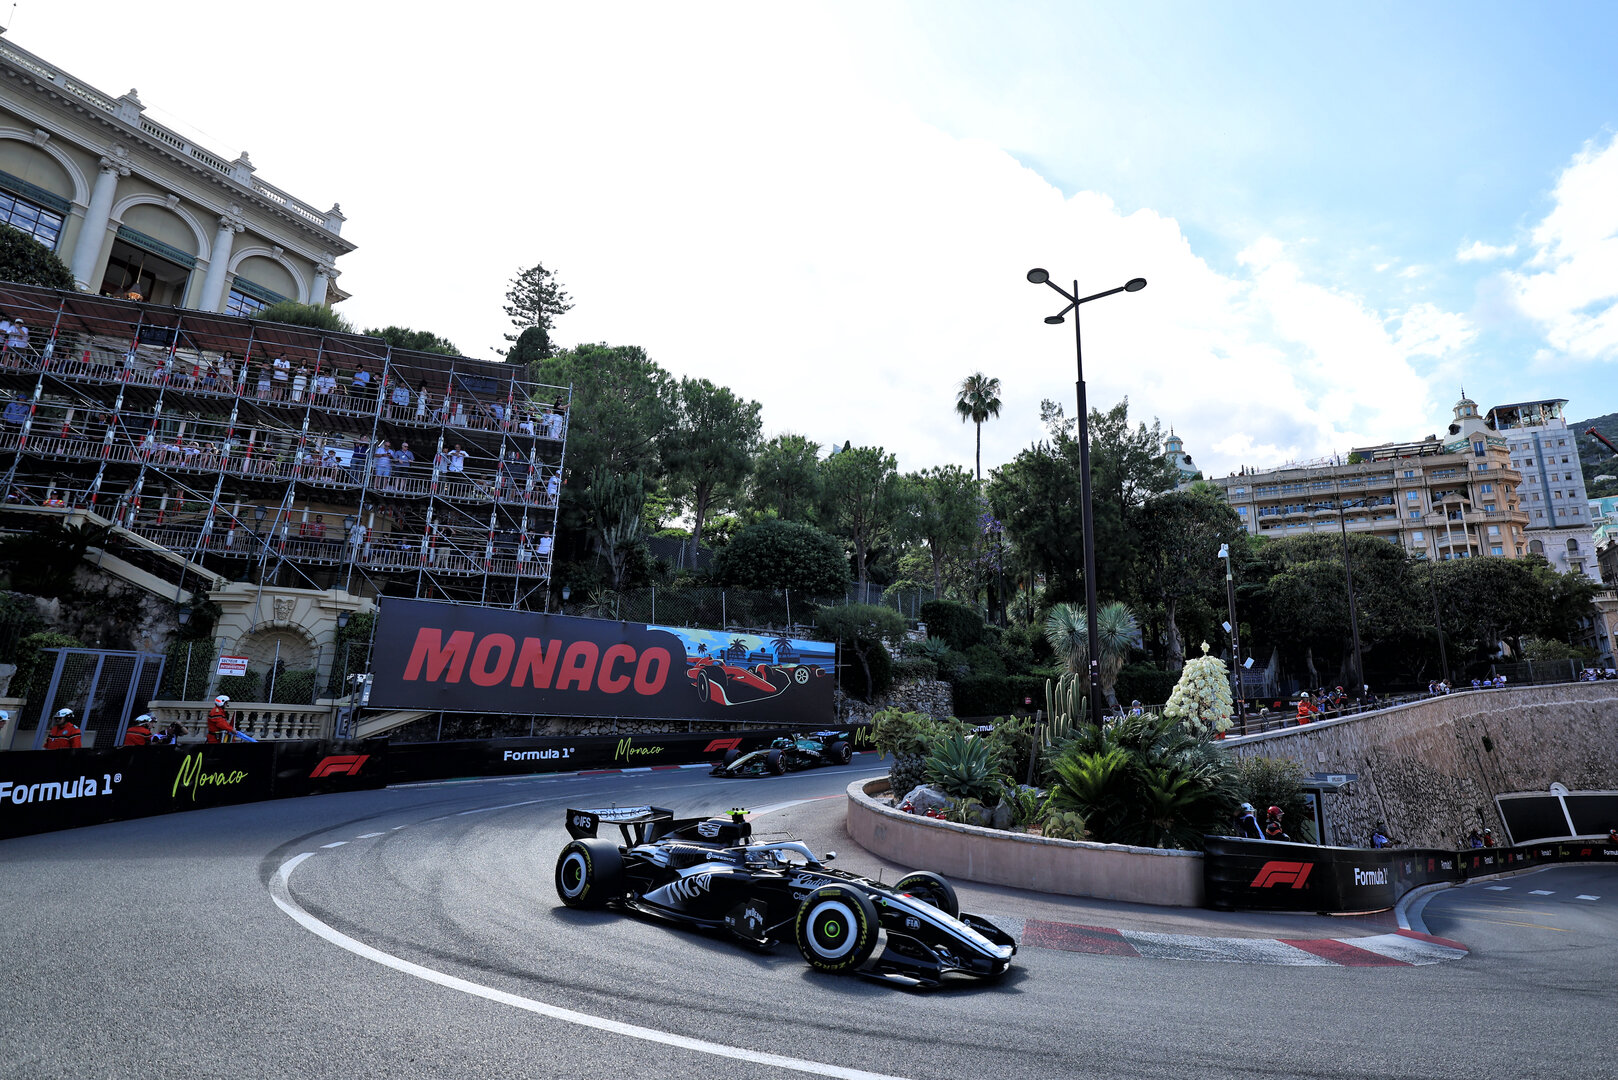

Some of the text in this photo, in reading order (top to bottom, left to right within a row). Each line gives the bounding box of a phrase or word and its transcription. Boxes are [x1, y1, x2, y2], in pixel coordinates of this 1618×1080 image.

[402, 627, 671, 695] MONACO
[503, 748, 560, 761] Formula
[614, 737, 664, 762] Monaco
[172, 752, 248, 801] Monaco
[0, 775, 97, 805] Formula
[1354, 867, 1384, 886] Formula
[906, 919, 920, 929] FIA
